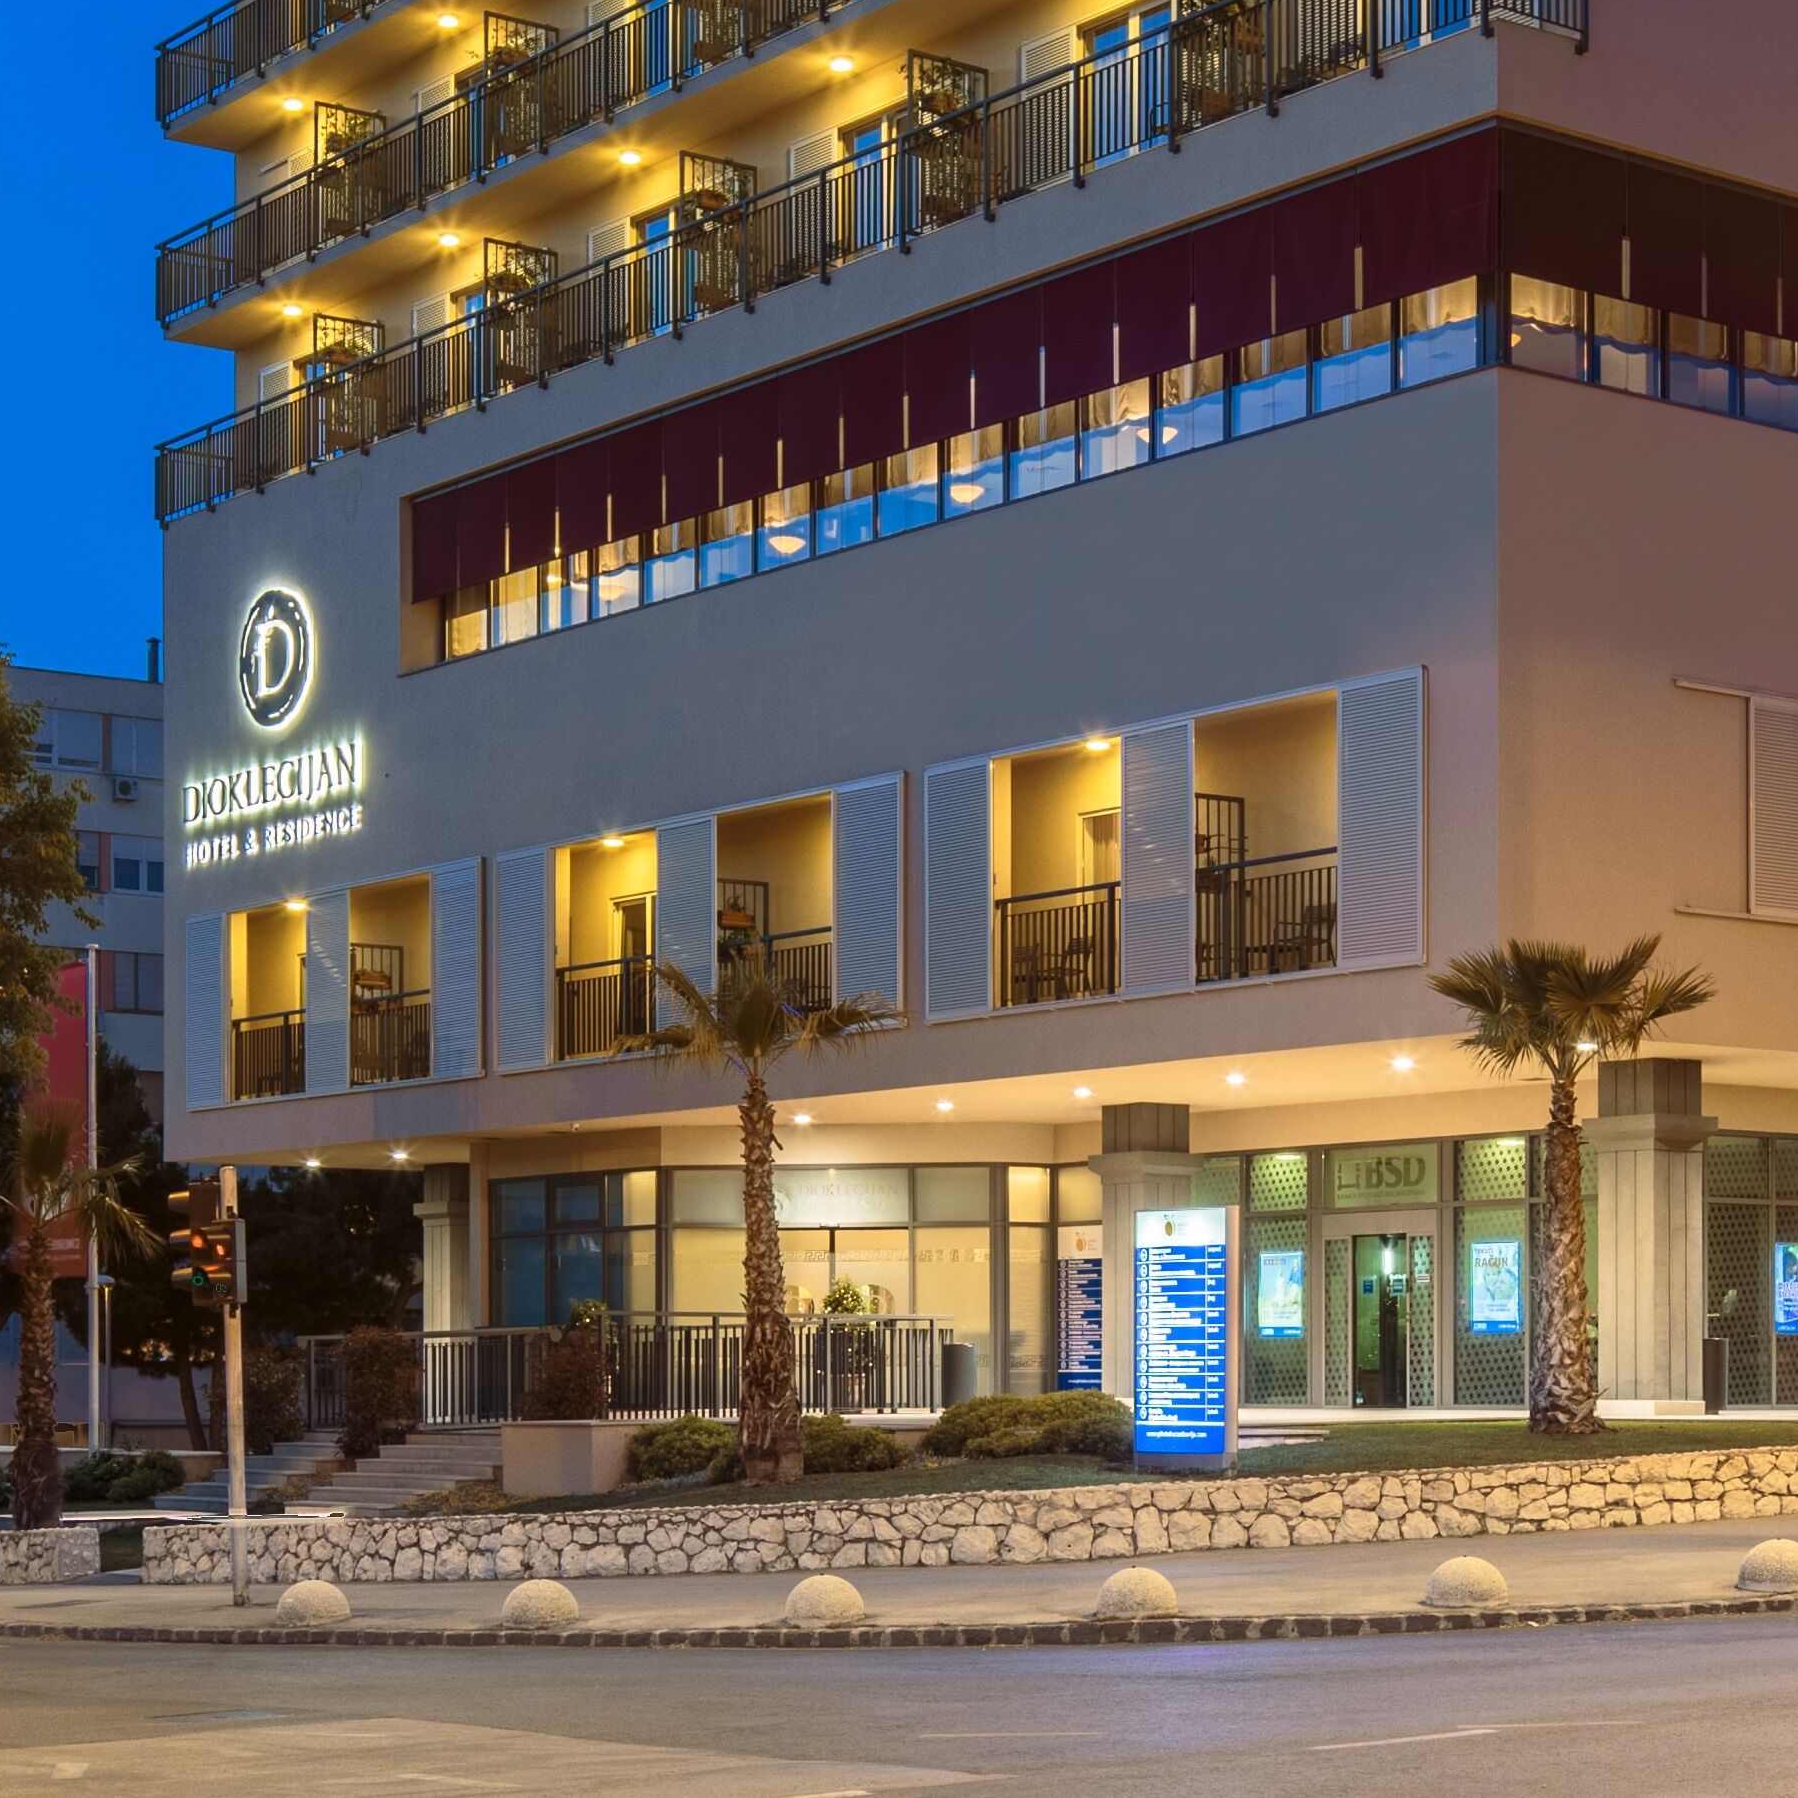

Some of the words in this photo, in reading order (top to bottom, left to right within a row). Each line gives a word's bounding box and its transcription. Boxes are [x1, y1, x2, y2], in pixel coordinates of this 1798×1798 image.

[182, 742, 359, 824] DIOKLECIJAN
[185, 834, 239, 869] HOTEL
[243, 827, 258, 856] &
[263, 805, 363, 850] RESIDENCE
[1365, 1155, 1427, 1189] BSD
